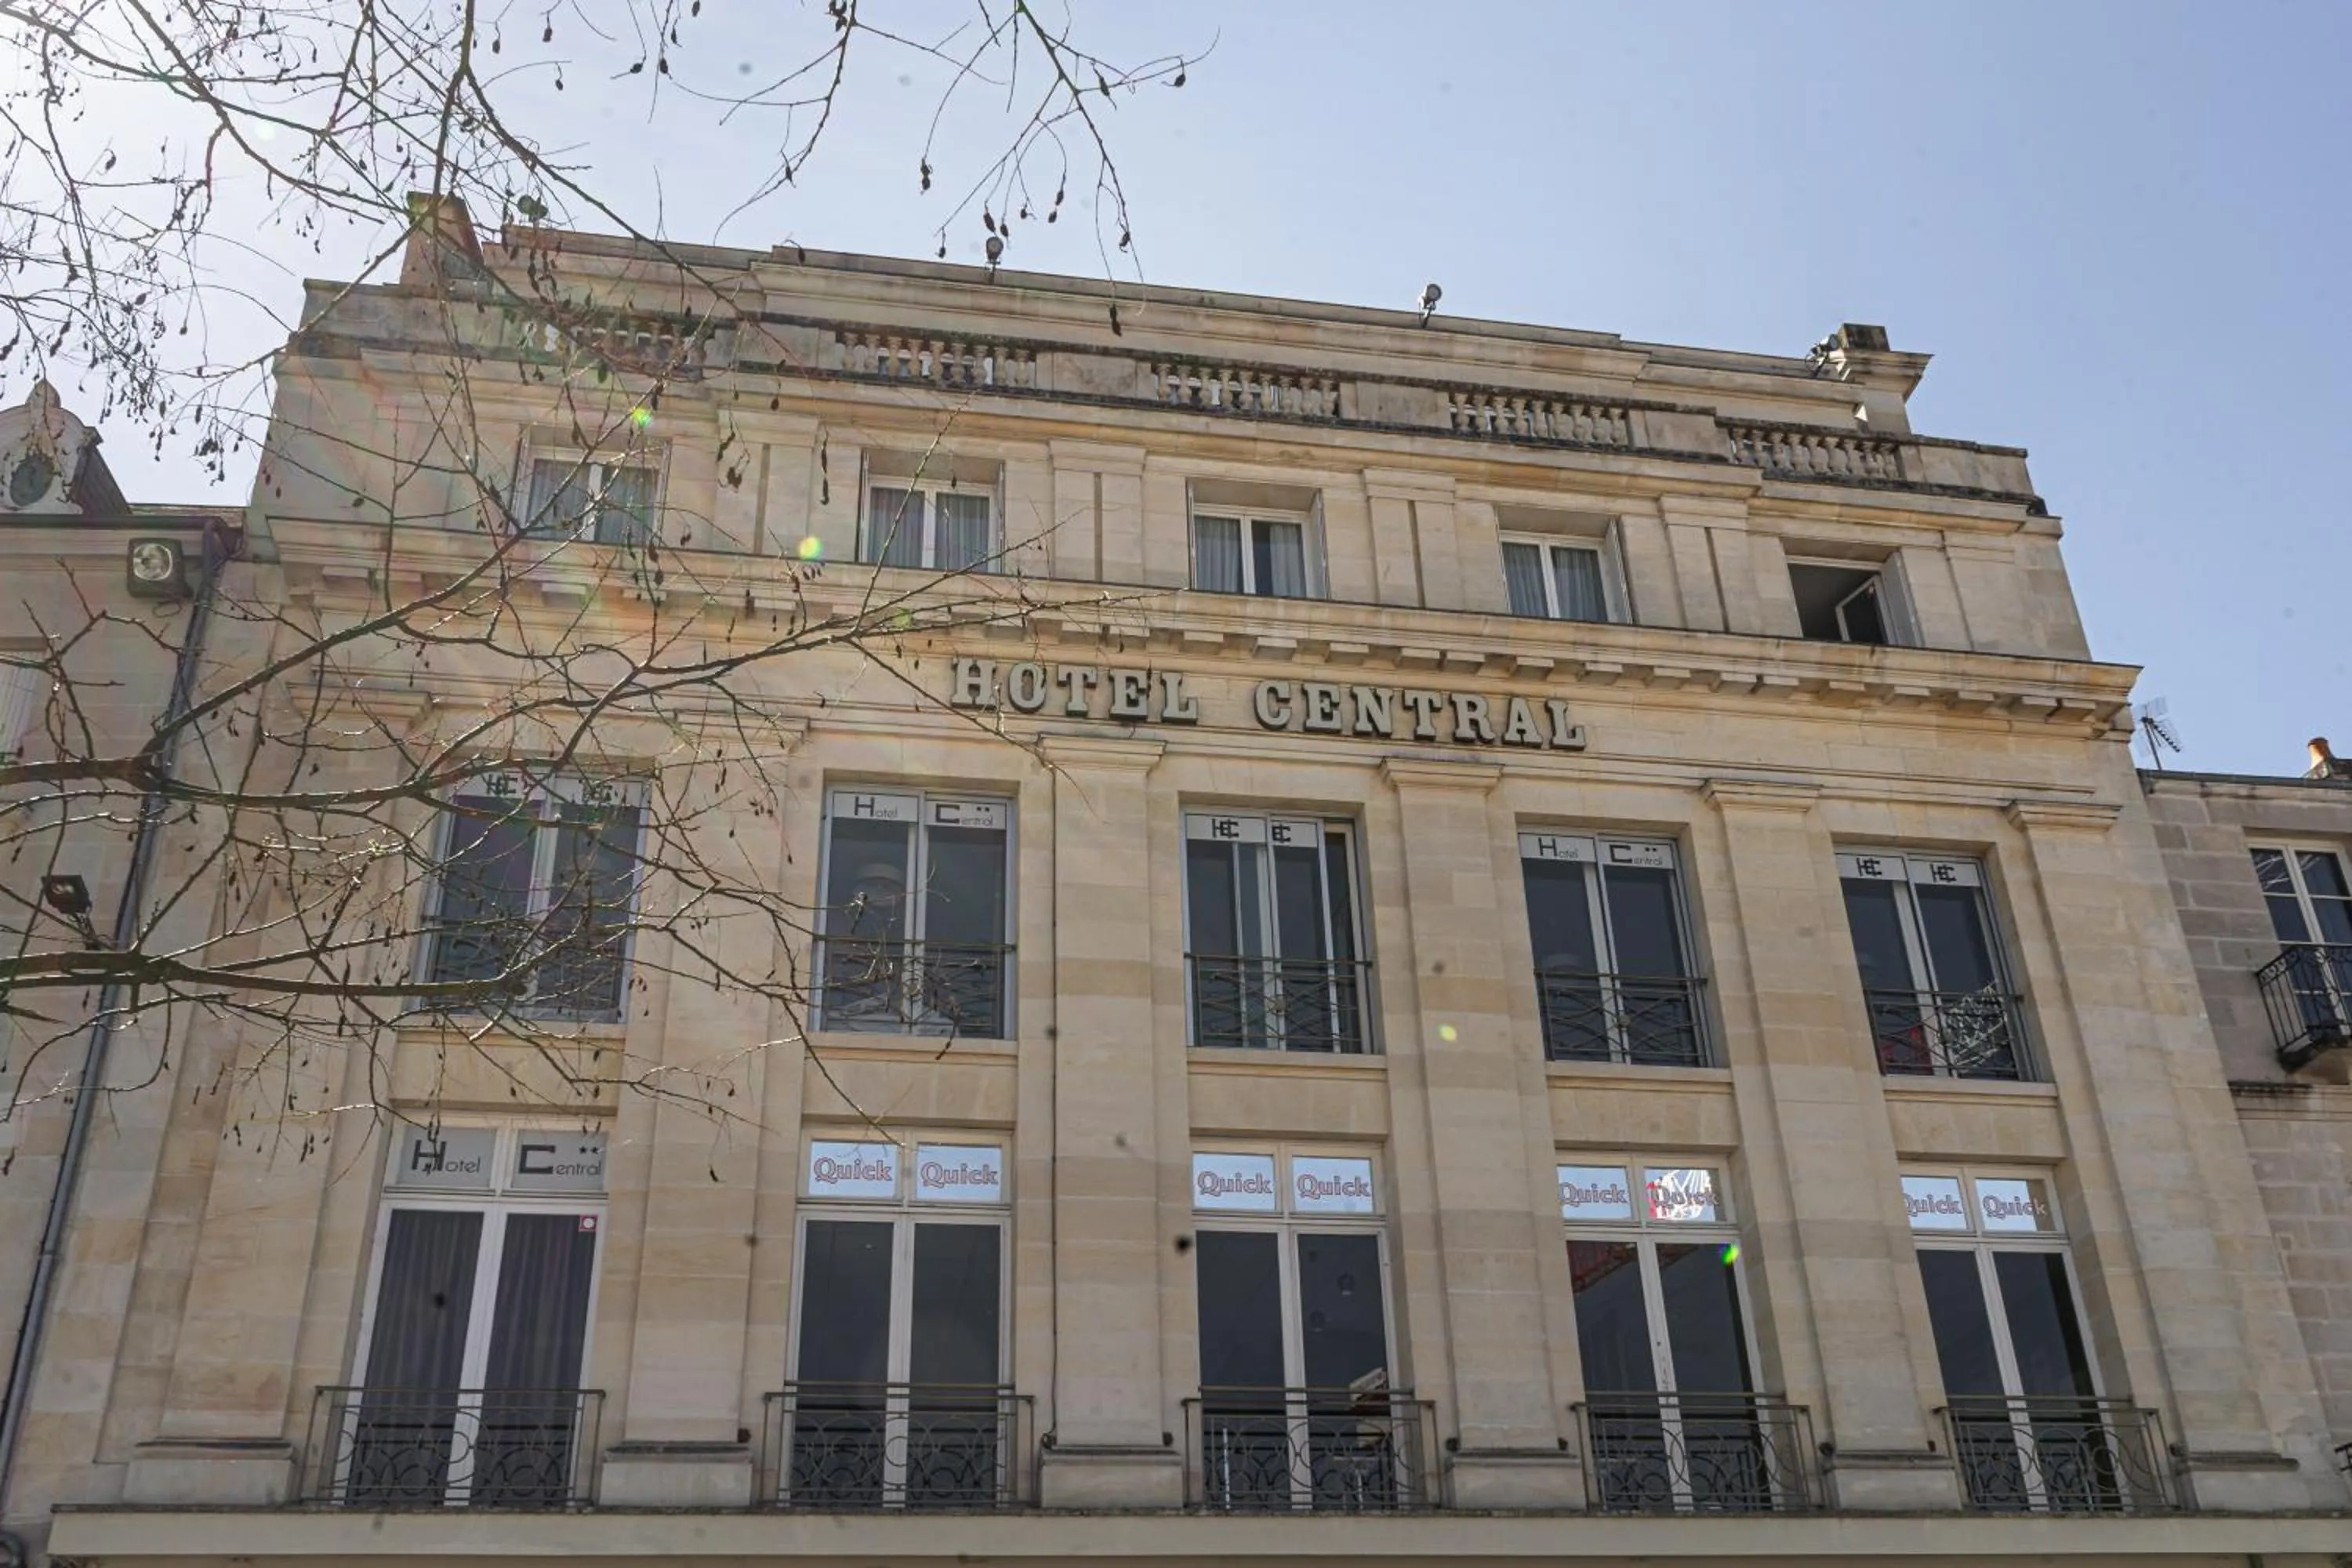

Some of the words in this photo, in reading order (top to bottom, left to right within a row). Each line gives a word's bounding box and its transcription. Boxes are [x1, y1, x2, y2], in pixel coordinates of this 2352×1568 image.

[950, 655, 1200, 727] HOTEL
[1254, 677, 1587, 752] CENTRAL
[854, 796, 899, 818] Hotel
[412, 1140, 480, 1173] Hotel
[517, 1145, 602, 1176] Central
[813, 1156, 893, 1185] Quick
[921, 1161, 999, 1189] Quick
[1197, 1171, 1273, 1196] Quick
[1297, 1174, 1372, 1200] Quick
[1559, 1182, 1628, 1207] Quick
[1983, 1195, 2048, 1219] Quick
